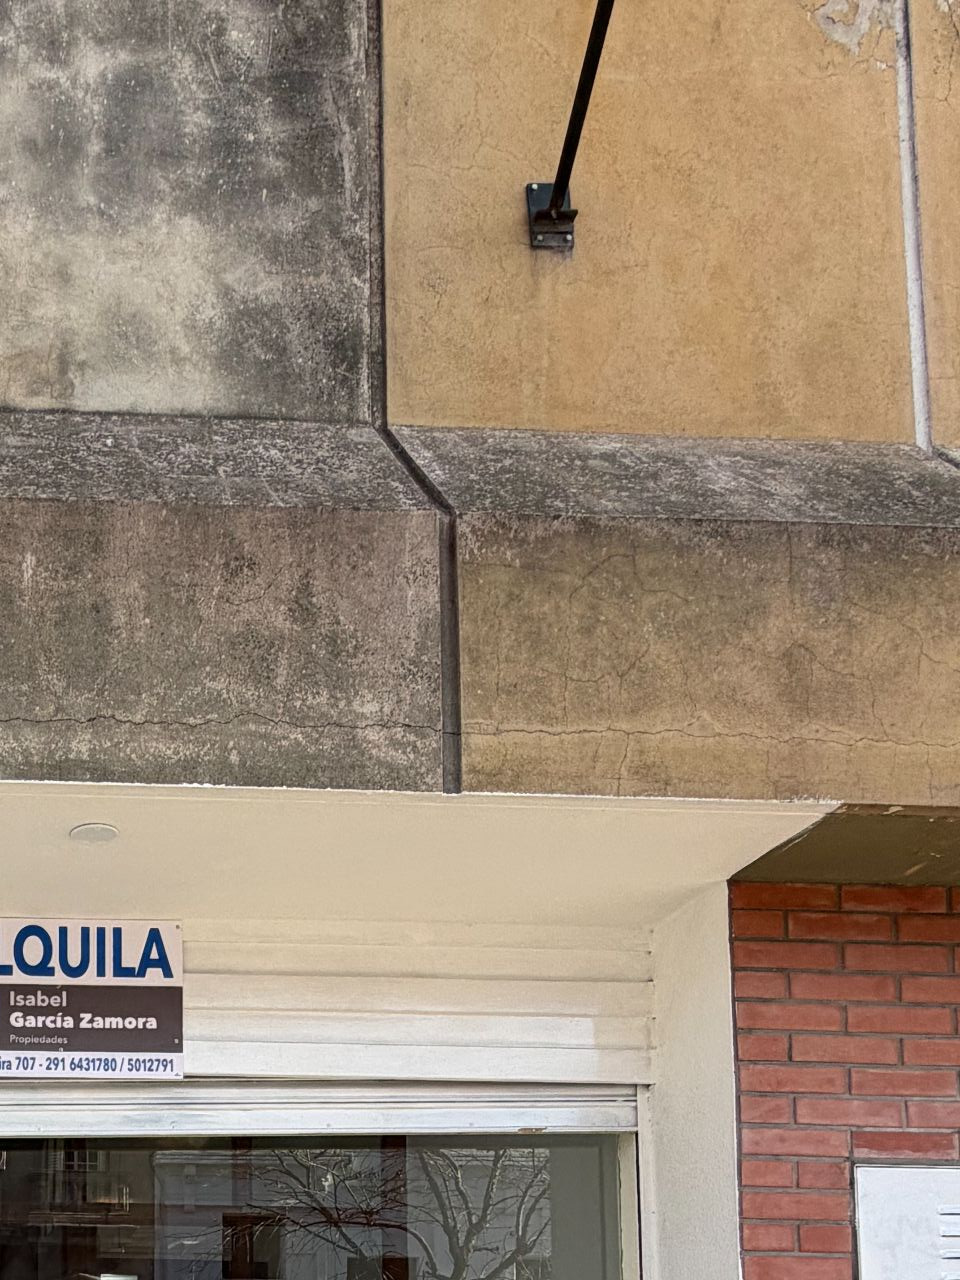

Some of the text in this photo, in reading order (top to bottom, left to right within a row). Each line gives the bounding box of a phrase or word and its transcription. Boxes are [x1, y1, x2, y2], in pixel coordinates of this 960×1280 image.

[10, 991, 67, 1007] Isabel
[10, 1011, 157, 1029] García Zamora
[10, 1034, 68, 1045] Propiedades
[15, 1057, 36, 1071] 707
[45, 1057, 66, 1072] 291
[69, 1058, 117, 1072] 6431780
[127, 1058, 174, 1073] 5012791
